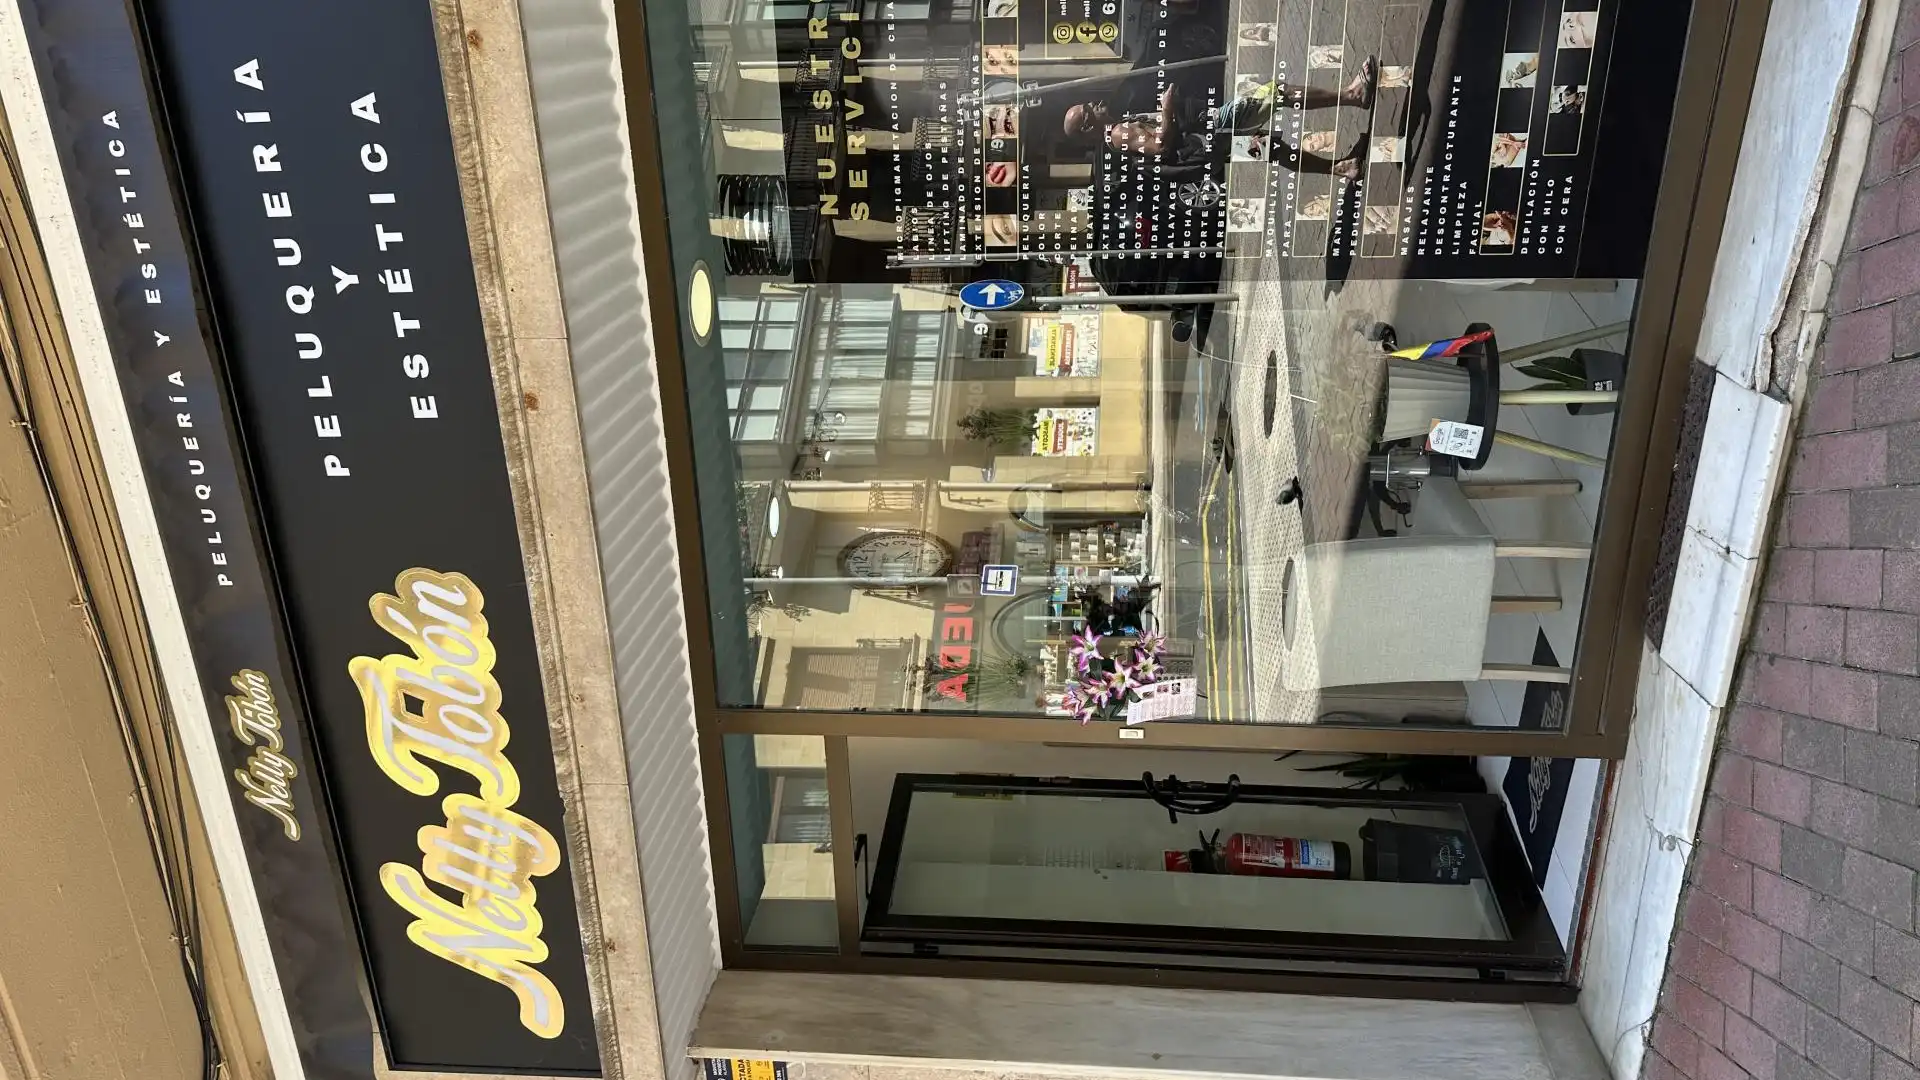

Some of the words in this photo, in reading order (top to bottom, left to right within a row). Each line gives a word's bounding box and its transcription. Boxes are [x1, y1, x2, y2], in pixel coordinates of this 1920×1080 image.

[887, 1, 895, 42] CEJA
[1102, 0, 1115, 14] 6
[1159, 29, 1166, 47] DE
[888, 53, 896, 71] DE
[971, 54, 980, 137] PESTAÑAS
[808, 0, 839, 215] NUESTR
[840, 12, 870, 220] SERVICI
[939, 81, 948, 163] PESTAÑAS
[956, 97, 964, 146] CEJAS
[1104, 124, 1112, 143] DE
[1156, 59, 1165, 144] PROFUNDA
[1205, 87, 1215, 152] HOMBRE
[1289, 90, 1301, 161] OCASION
[890, 82, 904, 260] MICROPIGMANETACION
[941, 174, 949, 190] DE
[957, 157, 965, 173] DE
[973, 148, 980, 165] DE
[1121, 111, 1129, 182] NATURAL
[1136, 135, 1145, 202] CAPILAR
[1202, 162, 1211, 200] PARA
[1265, 160, 1279, 257] MAQUILLAJE
[1275, 60, 1286, 131] PEINADO
[1435, 75, 1462, 255] DESCONTRACTURANTE
[100, 106, 163, 304] ESTÉTICA
[926, 191, 934, 207] DE
[958, 184, 966, 260] LAMINADO
[974, 175, 982, 260] EXTENSION
[1022, 164, 1030, 260] PELUQUERIA
[1086, 184, 1094, 259] KERATINA
[1102, 152, 1112, 259] EXTENSIONES
[1118, 192, 1127, 259] CABELLO
[1151, 153, 1161, 259] HIDRATACIÓN
[1167, 181, 1177, 258] BALAYAGE
[1216, 182, 1226, 258] BARBERIA
[1286, 172, 1295, 210] TODA
[1333, 177, 1346, 256] MANICURA
[1350, 179, 1363, 256] PEDICURA
[1401, 186, 1414, 255] MASAJES
[1418, 166, 1433, 255] RELAJANTE
[1452, 181, 1467, 255] LIMPIEZA
[1469, 200, 1482, 254] FACIAL
[1521, 158, 1540, 254] DEPILACIÓN
[1538, 225, 1548, 254] CON
[1543, 179, 1555, 215] HILO
[1555, 225, 1565, 254] CON
[1561, 175, 1573, 215] CERA
[349, 90, 440, 419] ESTÉTICA
[911, 207, 919, 260] LABIOS
[927, 217, 935, 260] LINEA
[942, 201, 950, 260] LIFTING
[1038, 212, 1046, 260] COLOR
[1053, 212, 1061, 260] CORTE
[1070, 195, 1078, 260] PEINADO
[1135, 211, 1143, 259] BOTOX
[1183, 198, 1192, 258] MECHAS
[1200, 210, 1208, 258] CORTE
[1282, 220, 1292, 257] PARA
[232, 56, 352, 477] PELUQUERÍA
[330, 263, 361, 294] Y
[153, 329, 171, 348] Y
[165, 369, 234, 587] PELUQUERÍA
[228, 672, 281, 750] Tobón
[357, 574, 512, 801] Tobón
[238, 749, 298, 839] Nelly
[389, 800, 556, 1032] Nelly
